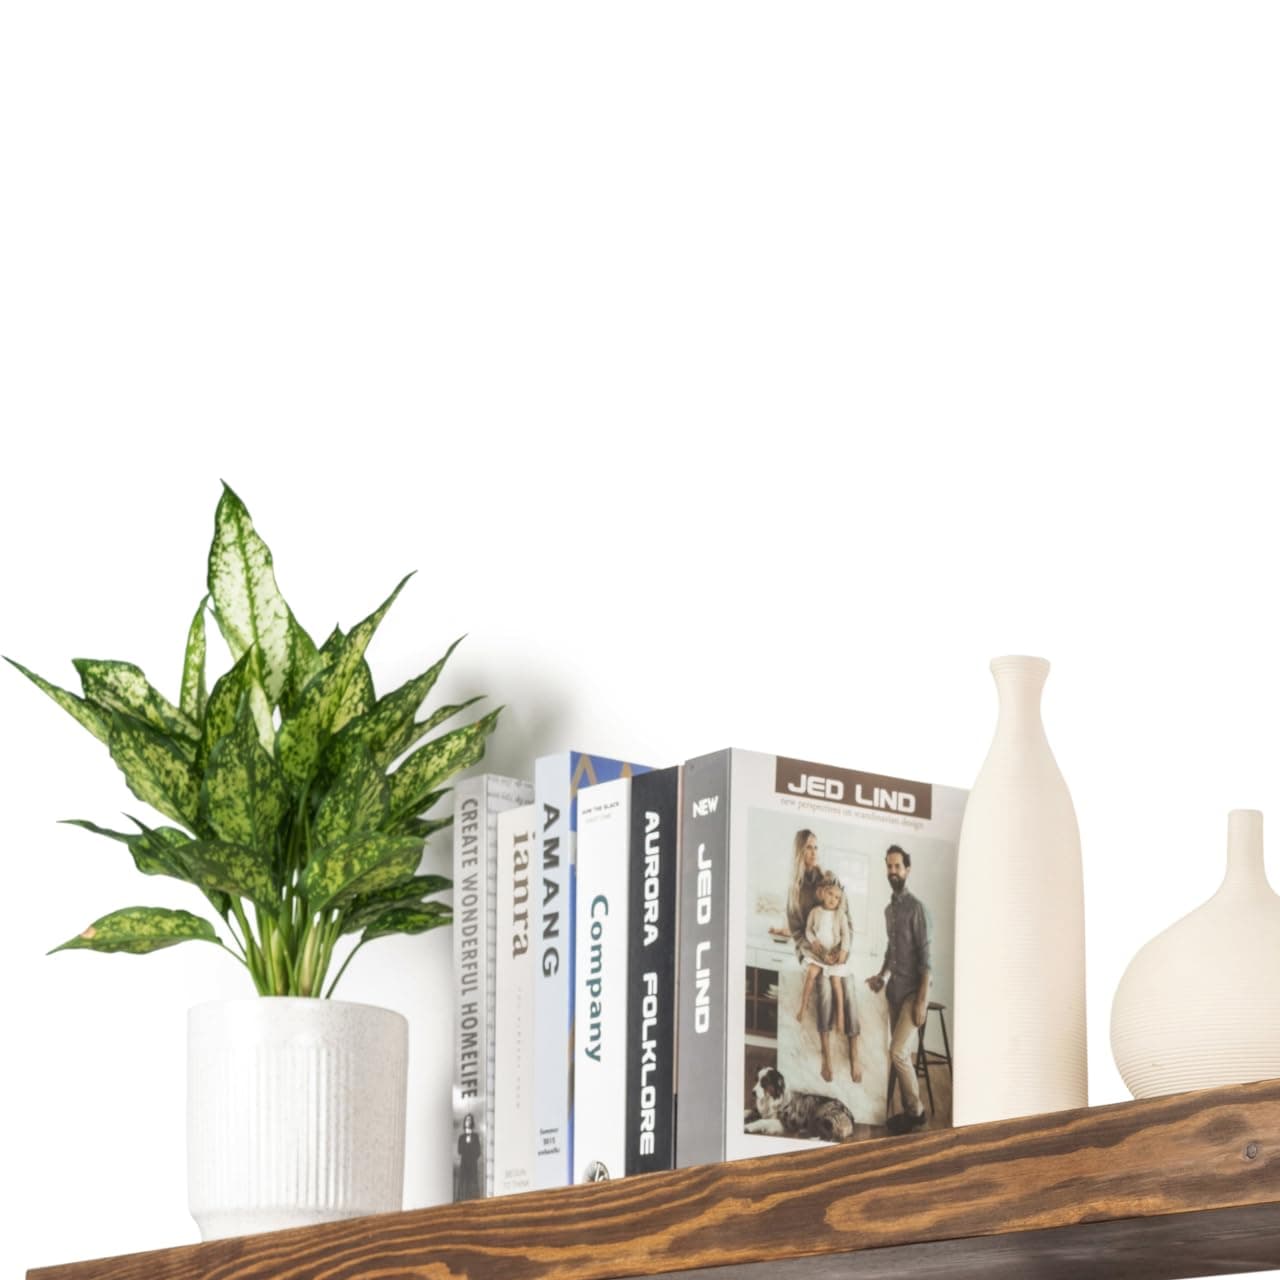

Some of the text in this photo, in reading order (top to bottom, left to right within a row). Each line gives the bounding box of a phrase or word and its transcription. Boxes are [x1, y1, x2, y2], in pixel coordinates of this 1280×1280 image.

[692, 796, 719, 818] NEW
[787, 773, 916, 814] JED LIND
[461, 798, 478, 1099] CREATE WONDERFUL HOMELIFE
[512, 831, 536, 960] ianra
[542, 804, 560, 978] AMANG
[694, 843, 711, 1034] JED LIND
[585, 894, 608, 1063] Company
[639, 811, 660, 1156] AURORA FOLKLORE
